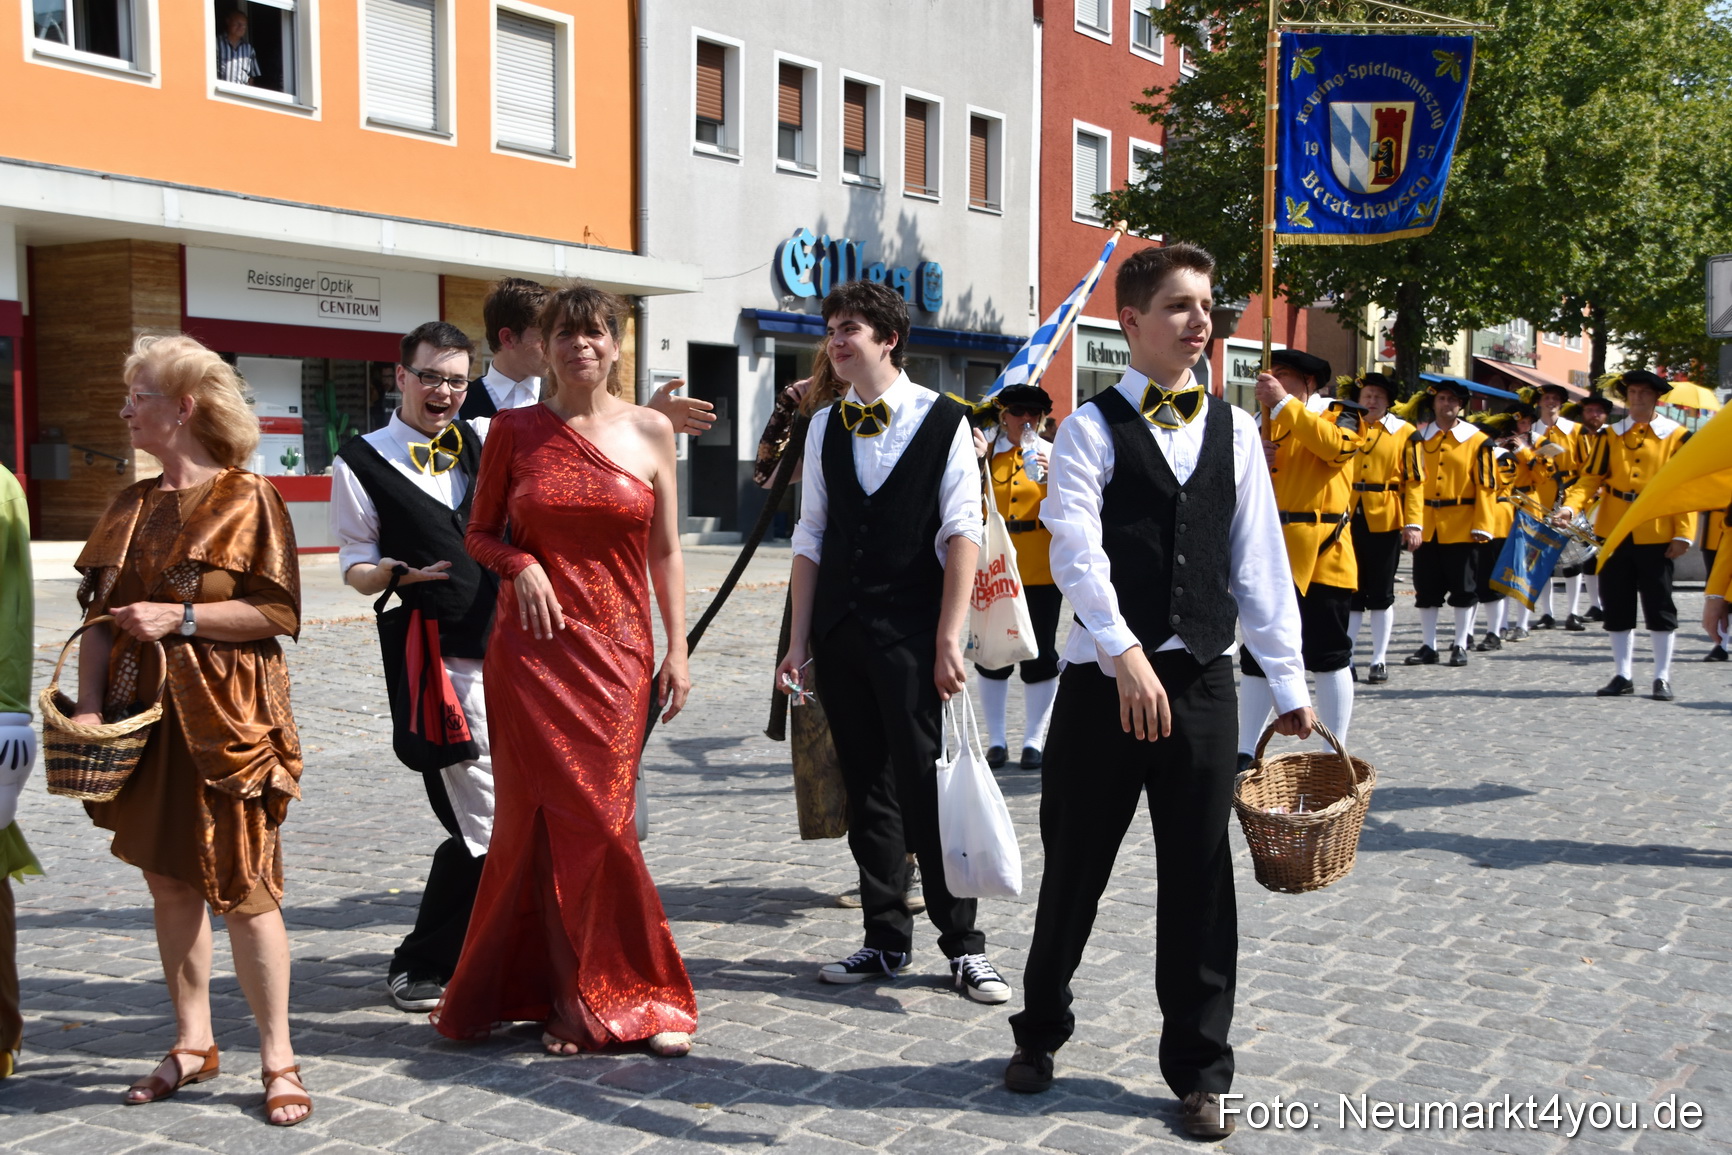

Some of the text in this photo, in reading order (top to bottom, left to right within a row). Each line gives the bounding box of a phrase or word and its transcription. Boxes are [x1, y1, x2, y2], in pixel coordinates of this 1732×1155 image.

[1295, 61, 1445, 130] Kolping-Spielmannszug
[1304, 141, 1320, 156] 19
[247, 269, 354, 294] Reissinger Optik
[320, 300, 379, 317] CENTRUM
[661, 338, 670, 351] 31
